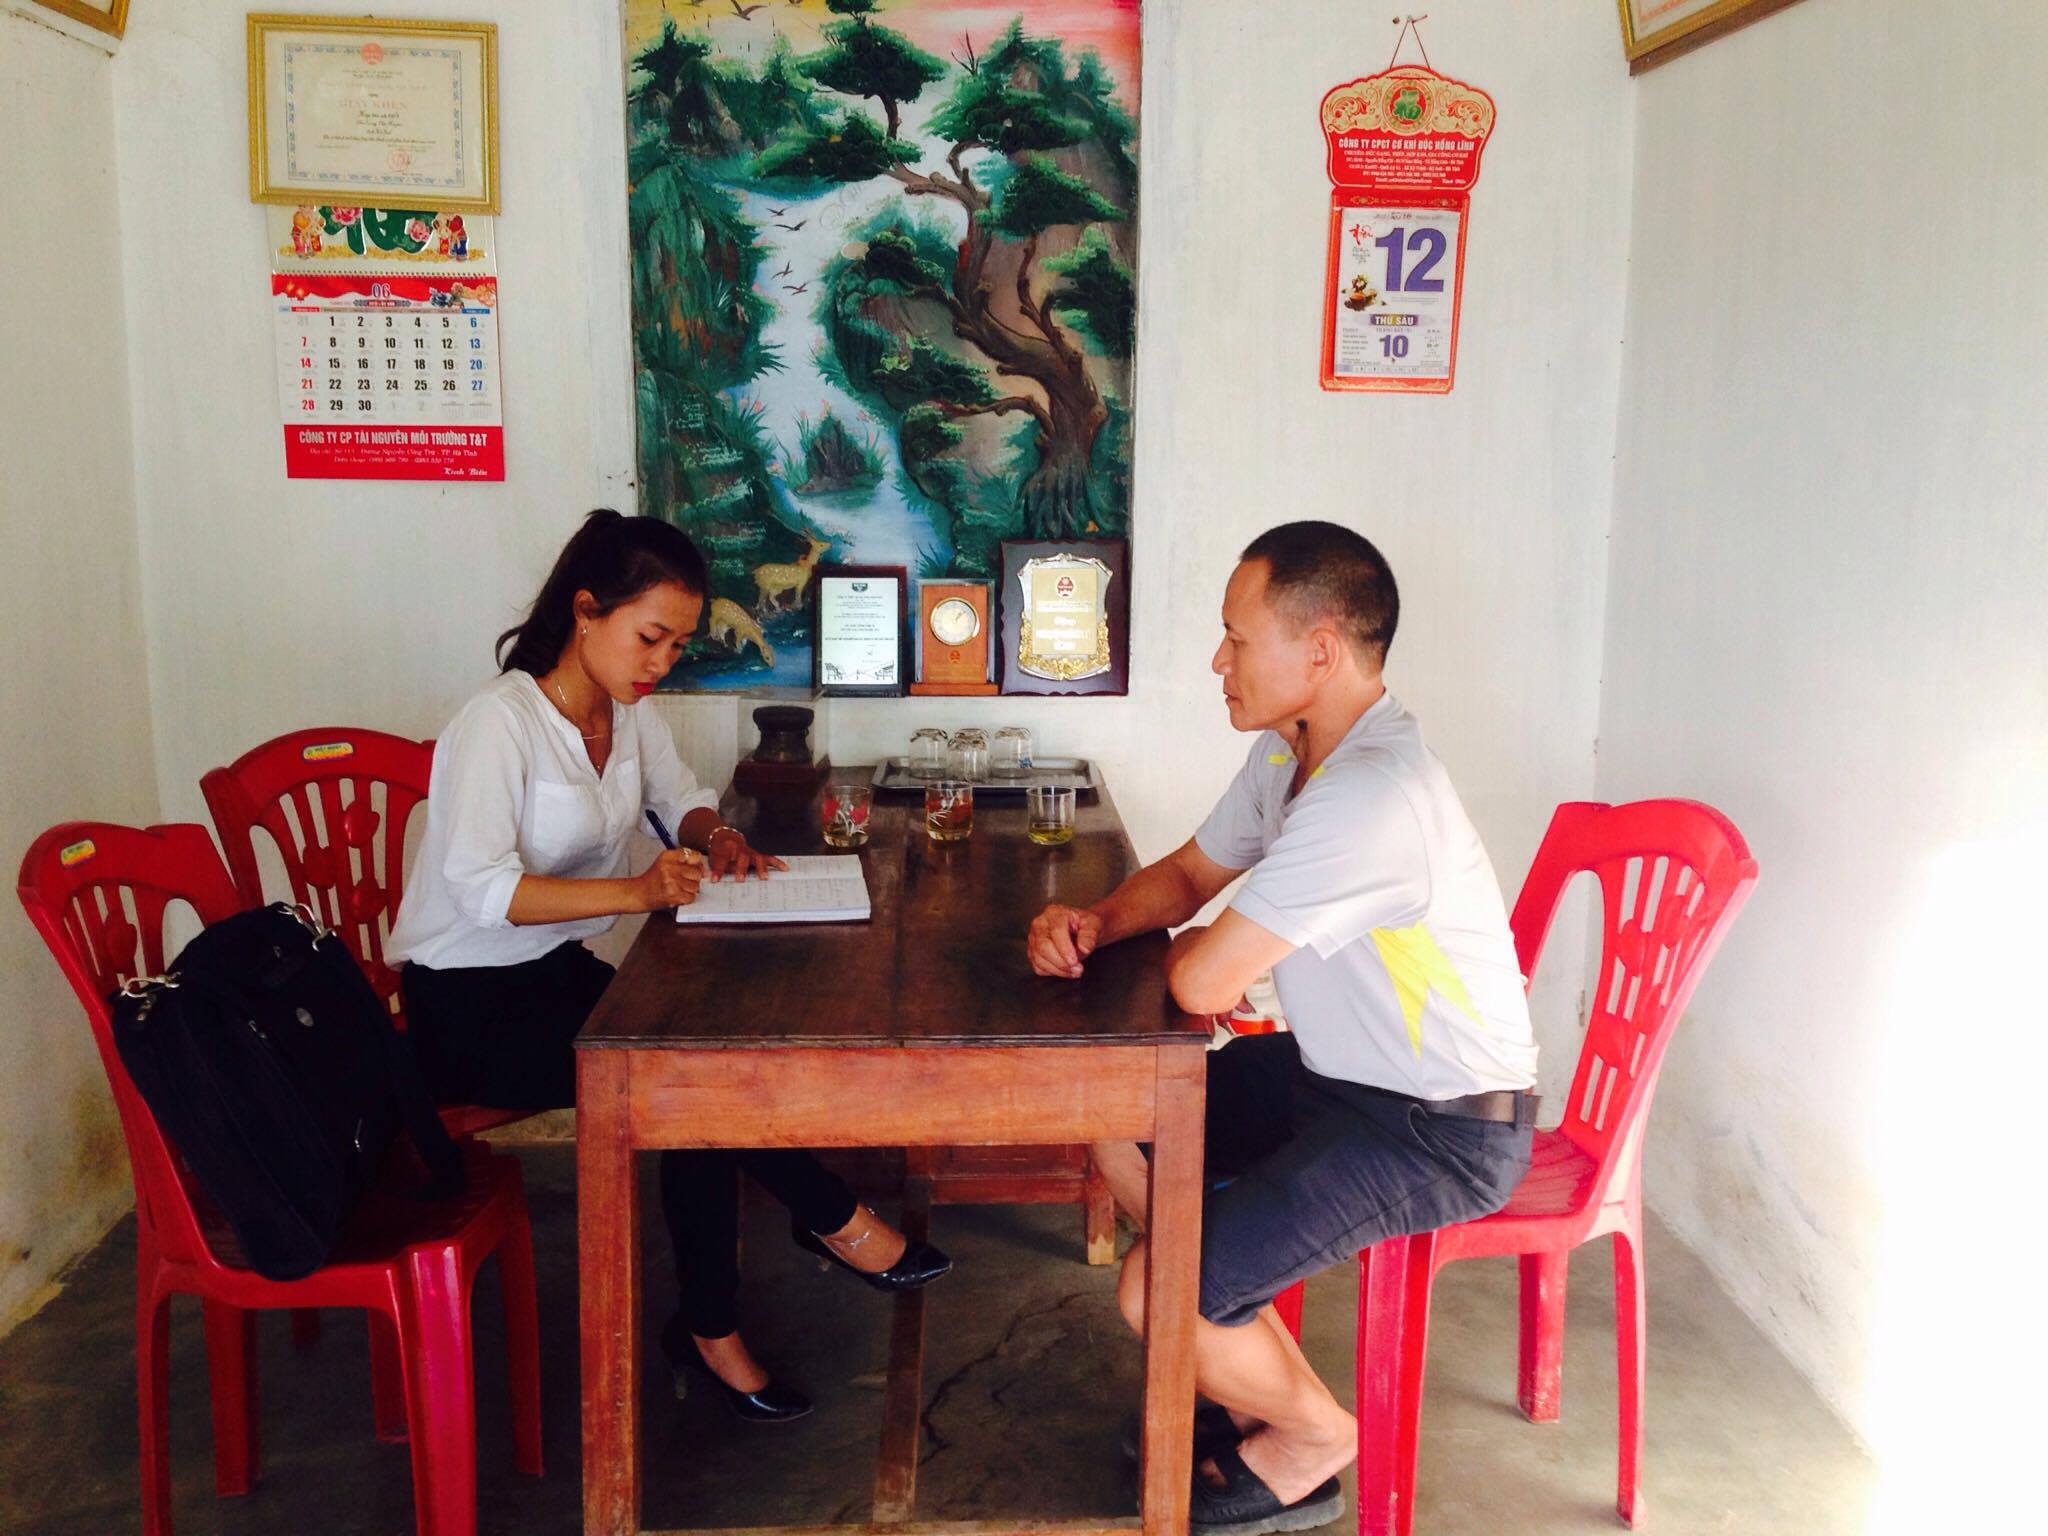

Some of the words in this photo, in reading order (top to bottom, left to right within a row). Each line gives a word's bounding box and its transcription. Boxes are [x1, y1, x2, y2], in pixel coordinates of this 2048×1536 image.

[1339, 137, 1359, 148] CÔNG
[1361, 139, 1370, 148] TY
[1375, 227, 1447, 292] 12
[372, 283, 391, 298] 06
[330, 316, 334, 326] 1
[358, 316, 364, 327] 2
[386, 316, 392, 327] 3
[415, 317, 421, 327] 4
[442, 317, 450, 328] 5
[469, 317, 477, 328] 6
[301, 336, 307, 347] 7
[330, 337, 336, 347] 8
[359, 337, 365, 348] 9
[384, 337, 397, 349] 10
[414, 338, 423, 348] 11
[442, 338, 452, 349] 12
[469, 337, 481, 349] 13
[1379, 334, 1409, 358] 10
[300, 357, 311, 368] 14
[329, 358, 340, 368] 15
[358, 358, 368, 369] 16
[387, 359, 396, 369] 17
[414, 359, 425, 369] 18
[443, 359, 454, 370] 19
[469, 359, 482, 370] 20
[301, 379, 313, 389] 21
[329, 379, 341, 389] 22
[358, 379, 370, 390] 23
[386, 379, 398, 390] 24
[415, 380, 427, 390] 25
[443, 380, 455, 390] 26
[471, 380, 482, 390] 27
[302, 400, 314, 410] 28
[330, 400, 343, 410] 29
[358, 400, 371, 411] 30
[299, 428, 324, 444] CÔNG
[326, 431, 337, 444] TY
[340, 432, 352, 444] CP
[354, 430, 369, 444] TÀI
[371, 430, 408, 444] NGUYÊN
[410, 430, 428, 444] MÔI
[431, 430, 467, 446] TRƯỜNG
[469, 433, 488, 446] T&T
